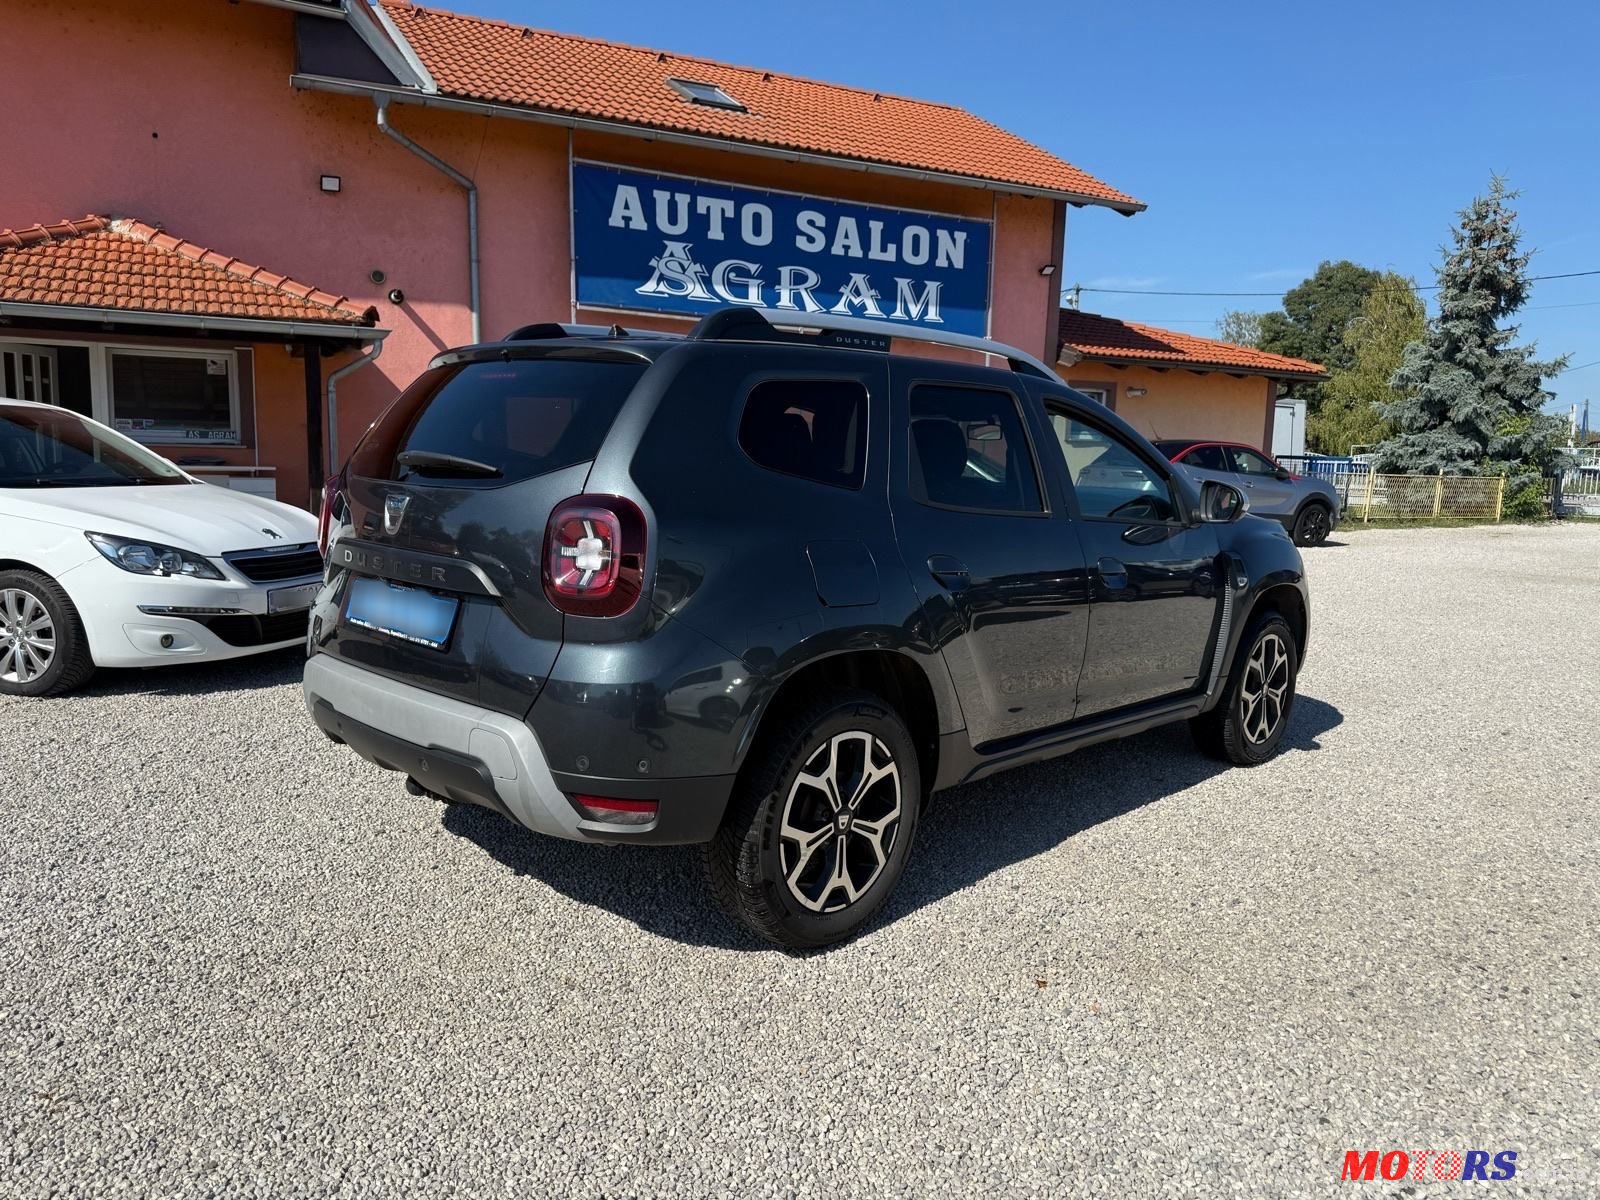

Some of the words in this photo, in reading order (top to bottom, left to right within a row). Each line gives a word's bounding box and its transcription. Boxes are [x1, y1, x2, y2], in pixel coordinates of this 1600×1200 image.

[608, 184, 774, 247] AUTO
[795, 210, 968, 270] SALON
[836, 336, 886, 347] DUSTER
[344, 549, 447, 583] DUSTER
